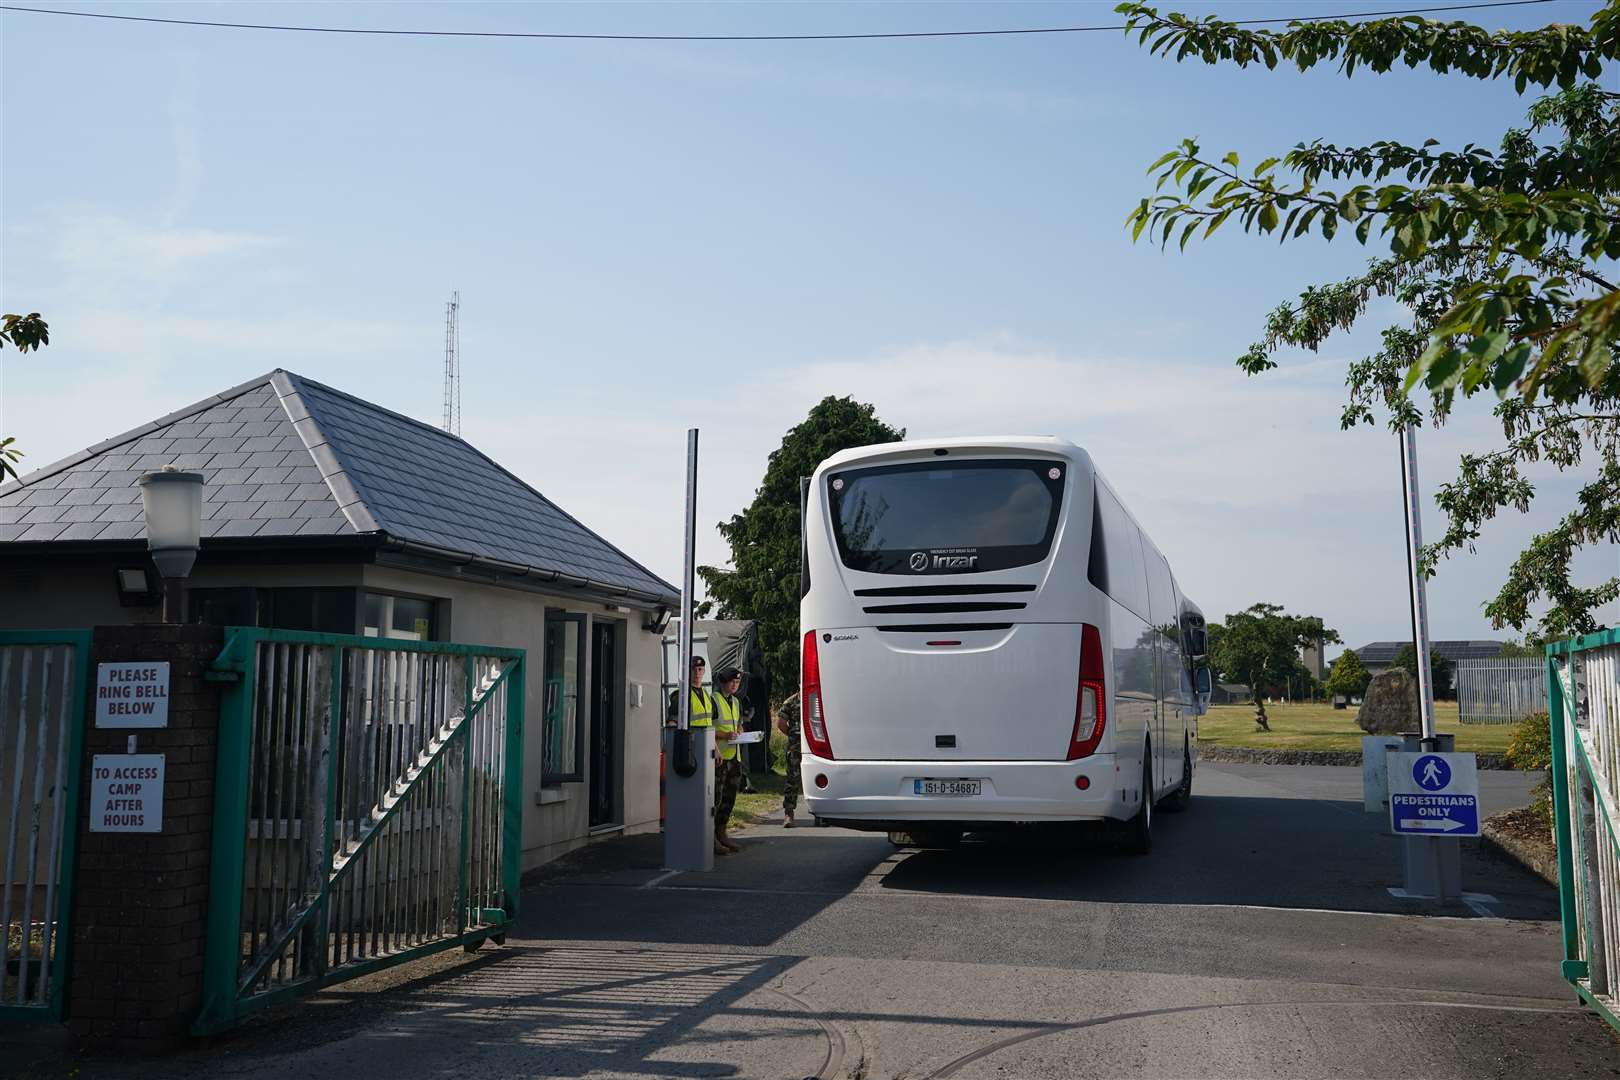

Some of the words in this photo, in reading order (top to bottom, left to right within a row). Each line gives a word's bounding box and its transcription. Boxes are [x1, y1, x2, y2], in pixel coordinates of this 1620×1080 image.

[109, 669, 157, 682] PLEASE
[99, 686, 131, 699] RING
[136, 685, 167, 698] BELL
[108, 702, 155, 715] BELOW
[94, 767, 110, 780] TO
[113, 767, 158, 780] ACCESS
[108, 783, 142, 796] CAMP
[925, 782, 977, 794] 151-D-54687
[105, 799, 143, 811] AFTER
[1393, 795, 1475, 806] PEDESTRIANS
[1418, 807, 1451, 817] ONLY
[103, 814, 145, 827] HOURS
